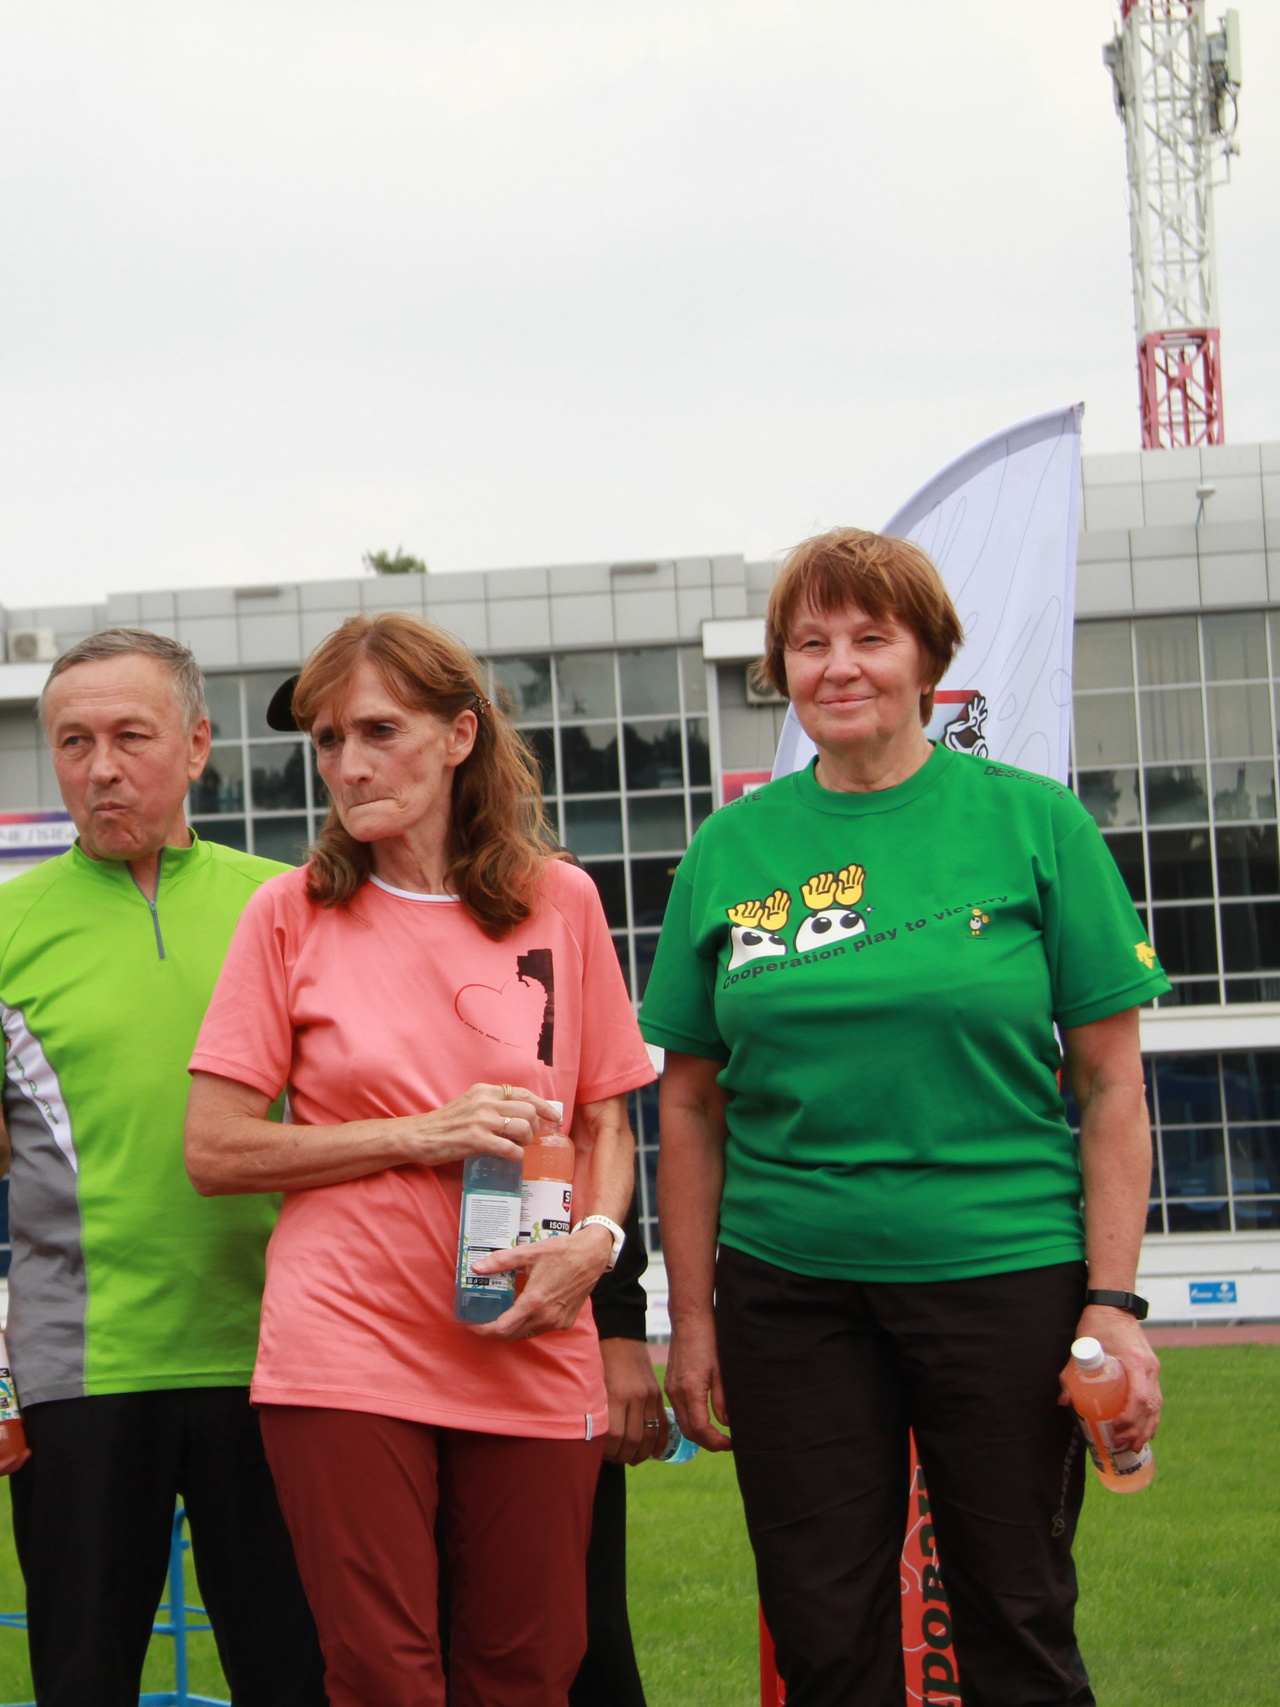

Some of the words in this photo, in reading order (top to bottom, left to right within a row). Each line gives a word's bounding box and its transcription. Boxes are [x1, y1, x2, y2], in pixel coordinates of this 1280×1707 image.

[984, 765, 1069, 800] DESCENTE
[853, 928, 897, 952] play
[905, 919, 927, 932] to
[933, 896, 1008, 920] victory
[549, 1221, 570, 1231] ISOTO
